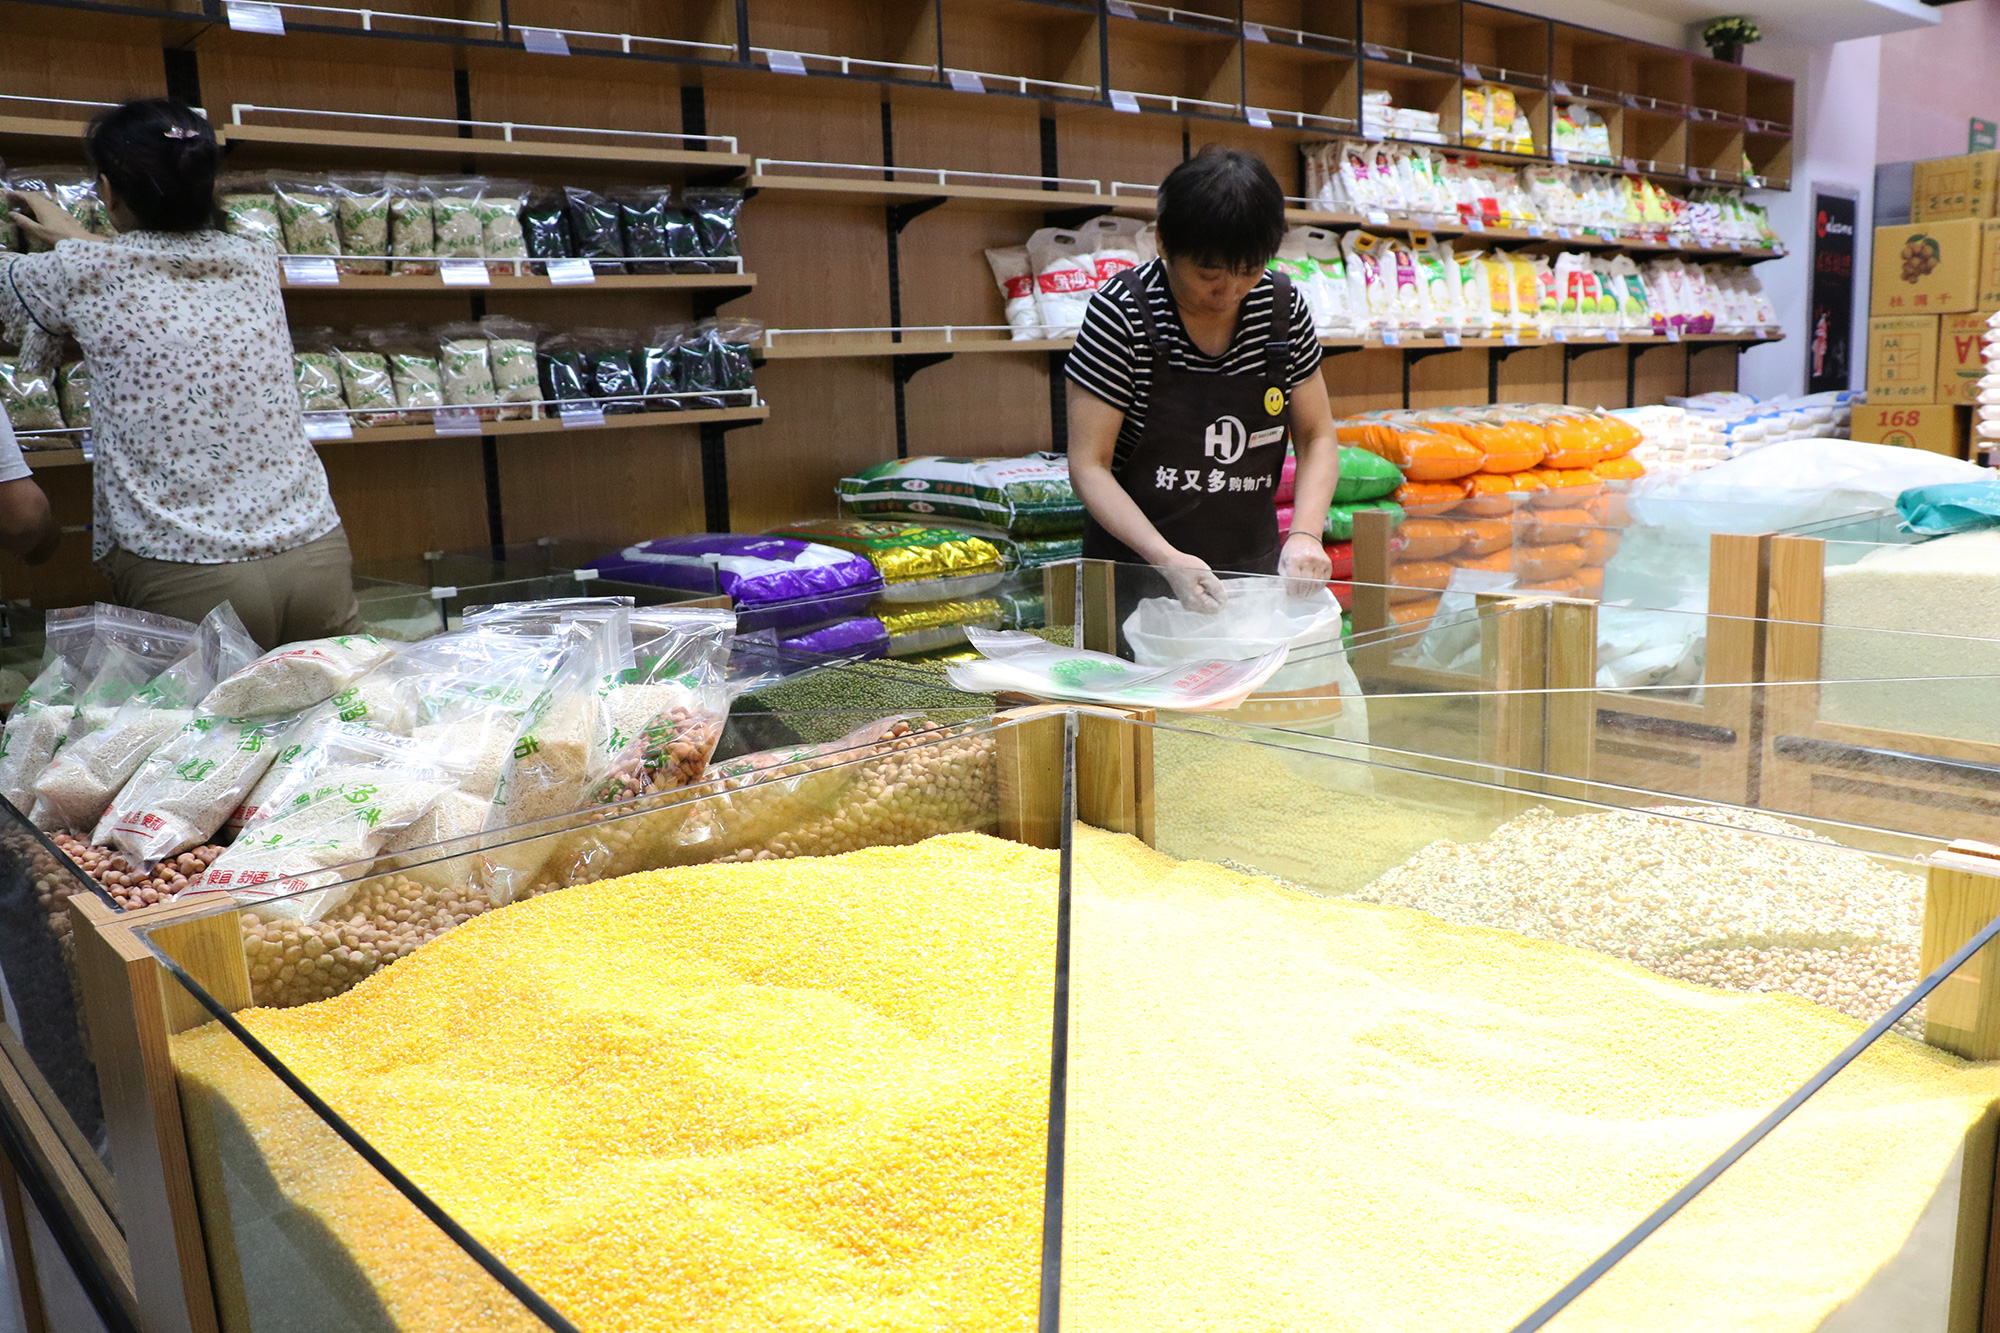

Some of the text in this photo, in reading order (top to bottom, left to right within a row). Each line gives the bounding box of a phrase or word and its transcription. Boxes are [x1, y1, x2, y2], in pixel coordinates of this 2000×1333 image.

[1877, 410, 1921, 427] 168
[207, 869, 234, 884] 便宜
[237, 870, 268, 885] 舒适
